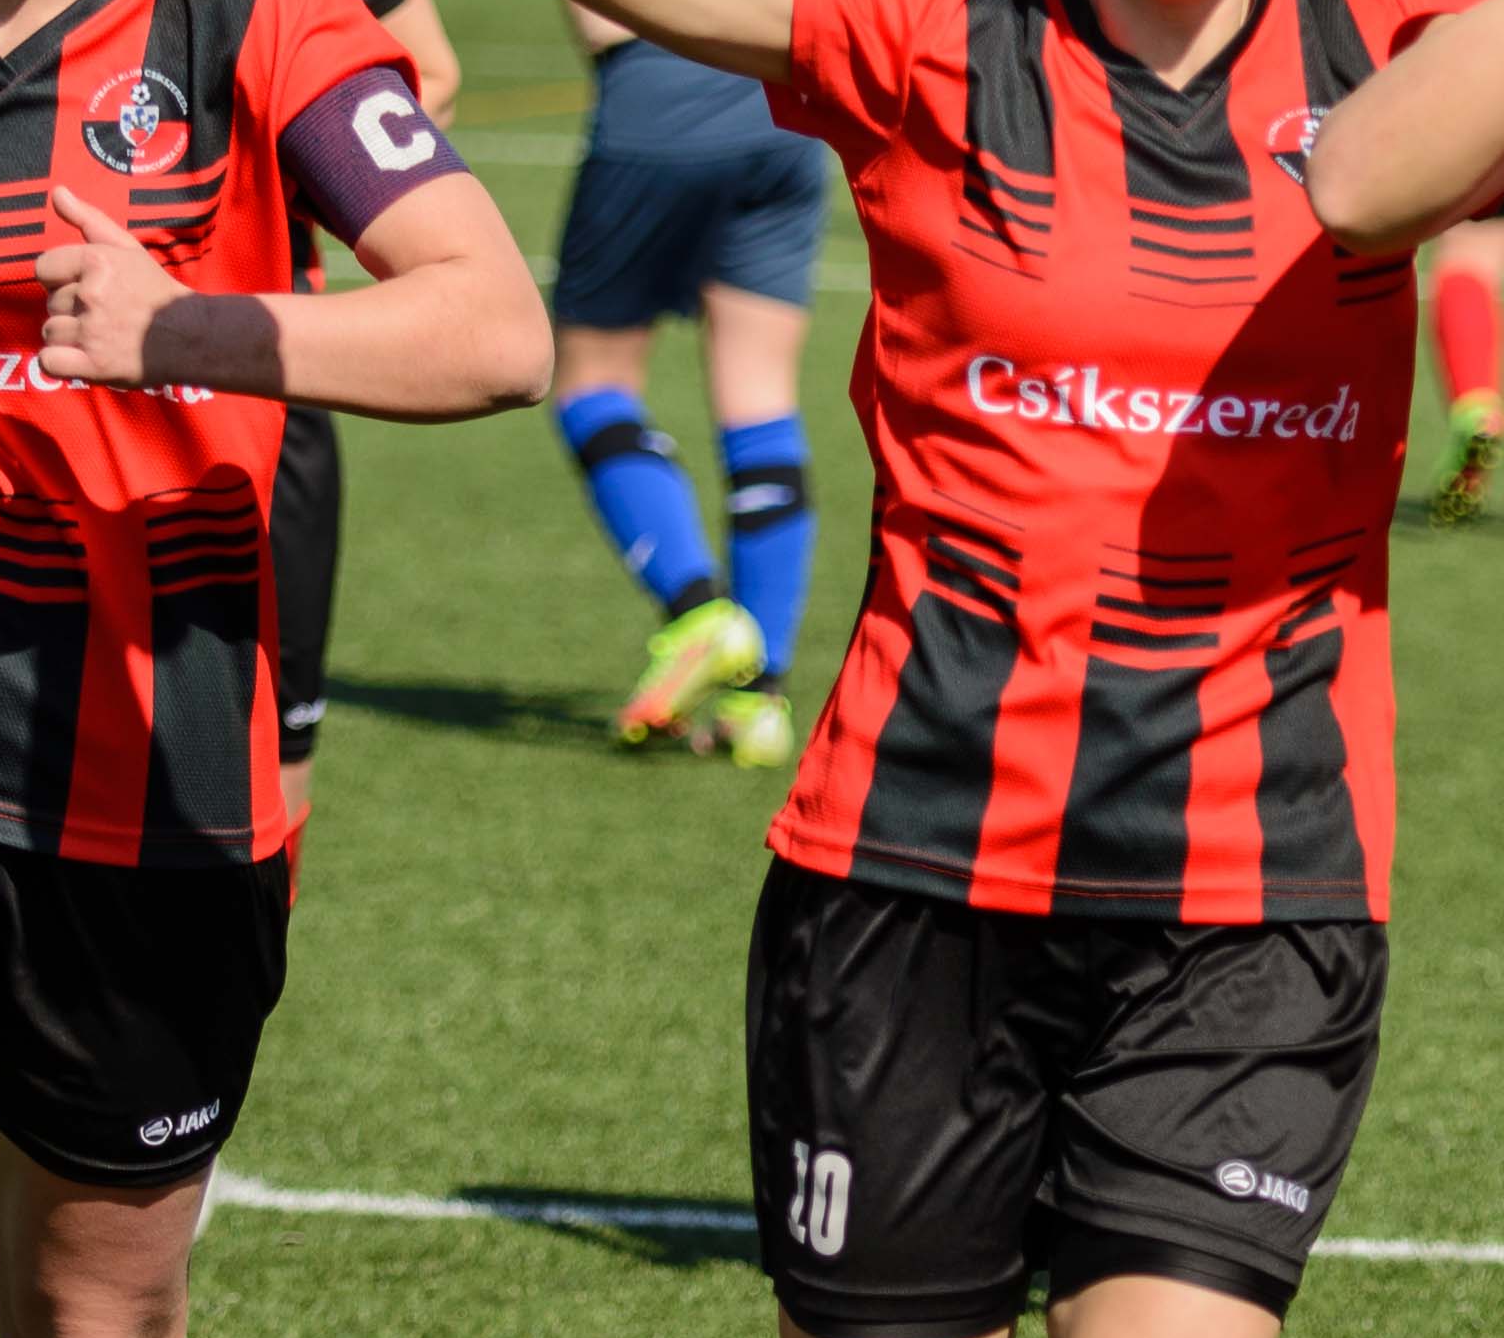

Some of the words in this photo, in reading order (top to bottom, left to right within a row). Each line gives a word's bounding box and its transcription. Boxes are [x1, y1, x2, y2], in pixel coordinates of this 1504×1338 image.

[351, 89, 437, 172] C
[966, 355, 1360, 443] Csíkszereda
[175, 1098, 220, 1136] JAKO
[1257, 1173, 1309, 1213] JAKO
